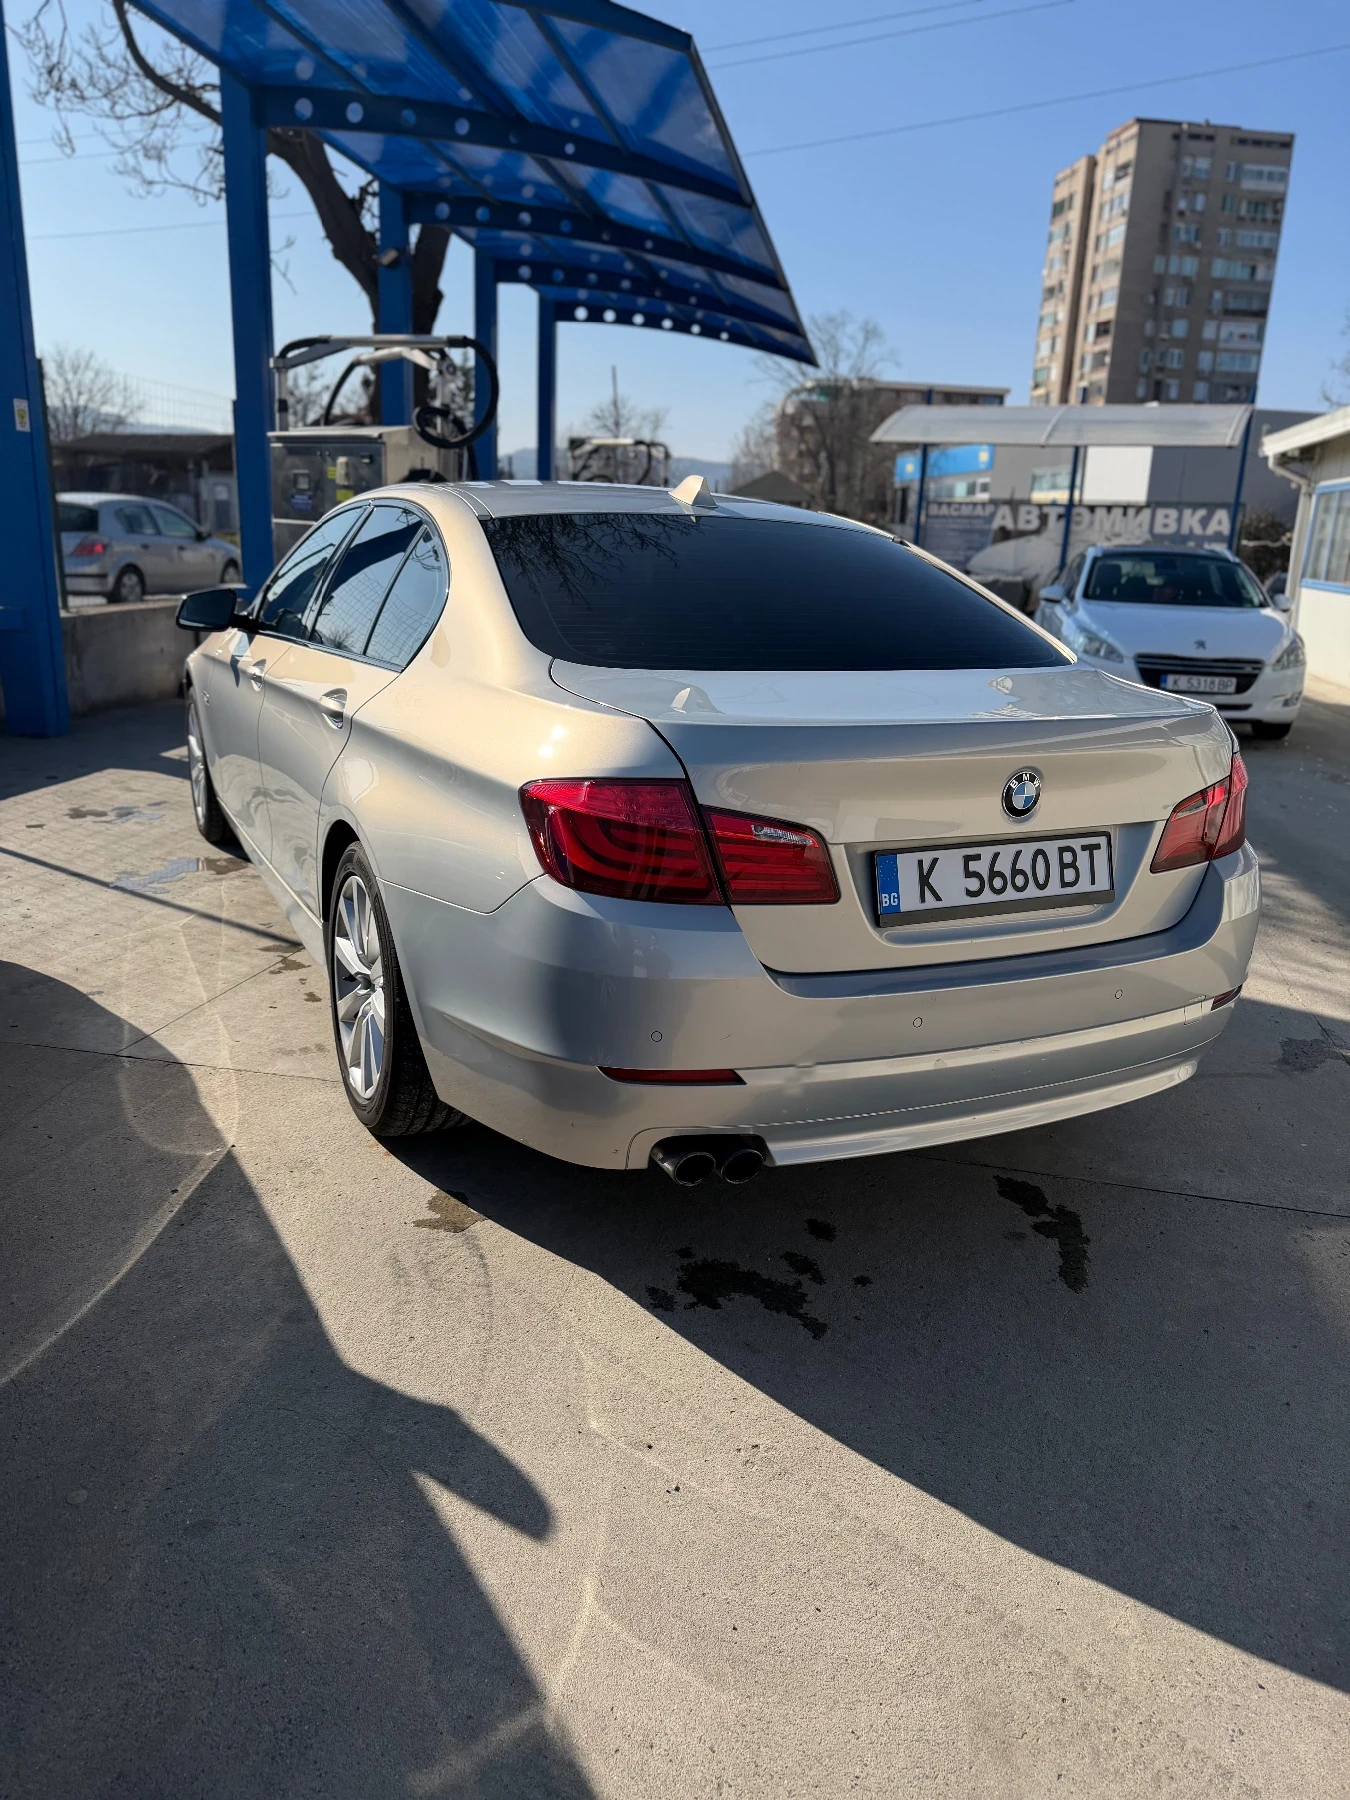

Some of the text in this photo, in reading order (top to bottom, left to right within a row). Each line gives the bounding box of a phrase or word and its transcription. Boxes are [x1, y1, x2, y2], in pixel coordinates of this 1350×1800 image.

[1172, 676, 1181, 689] K
[1009, 773, 1041, 789] BMW
[917, 857, 943, 904] K
[881, 892, 899, 907] BG
